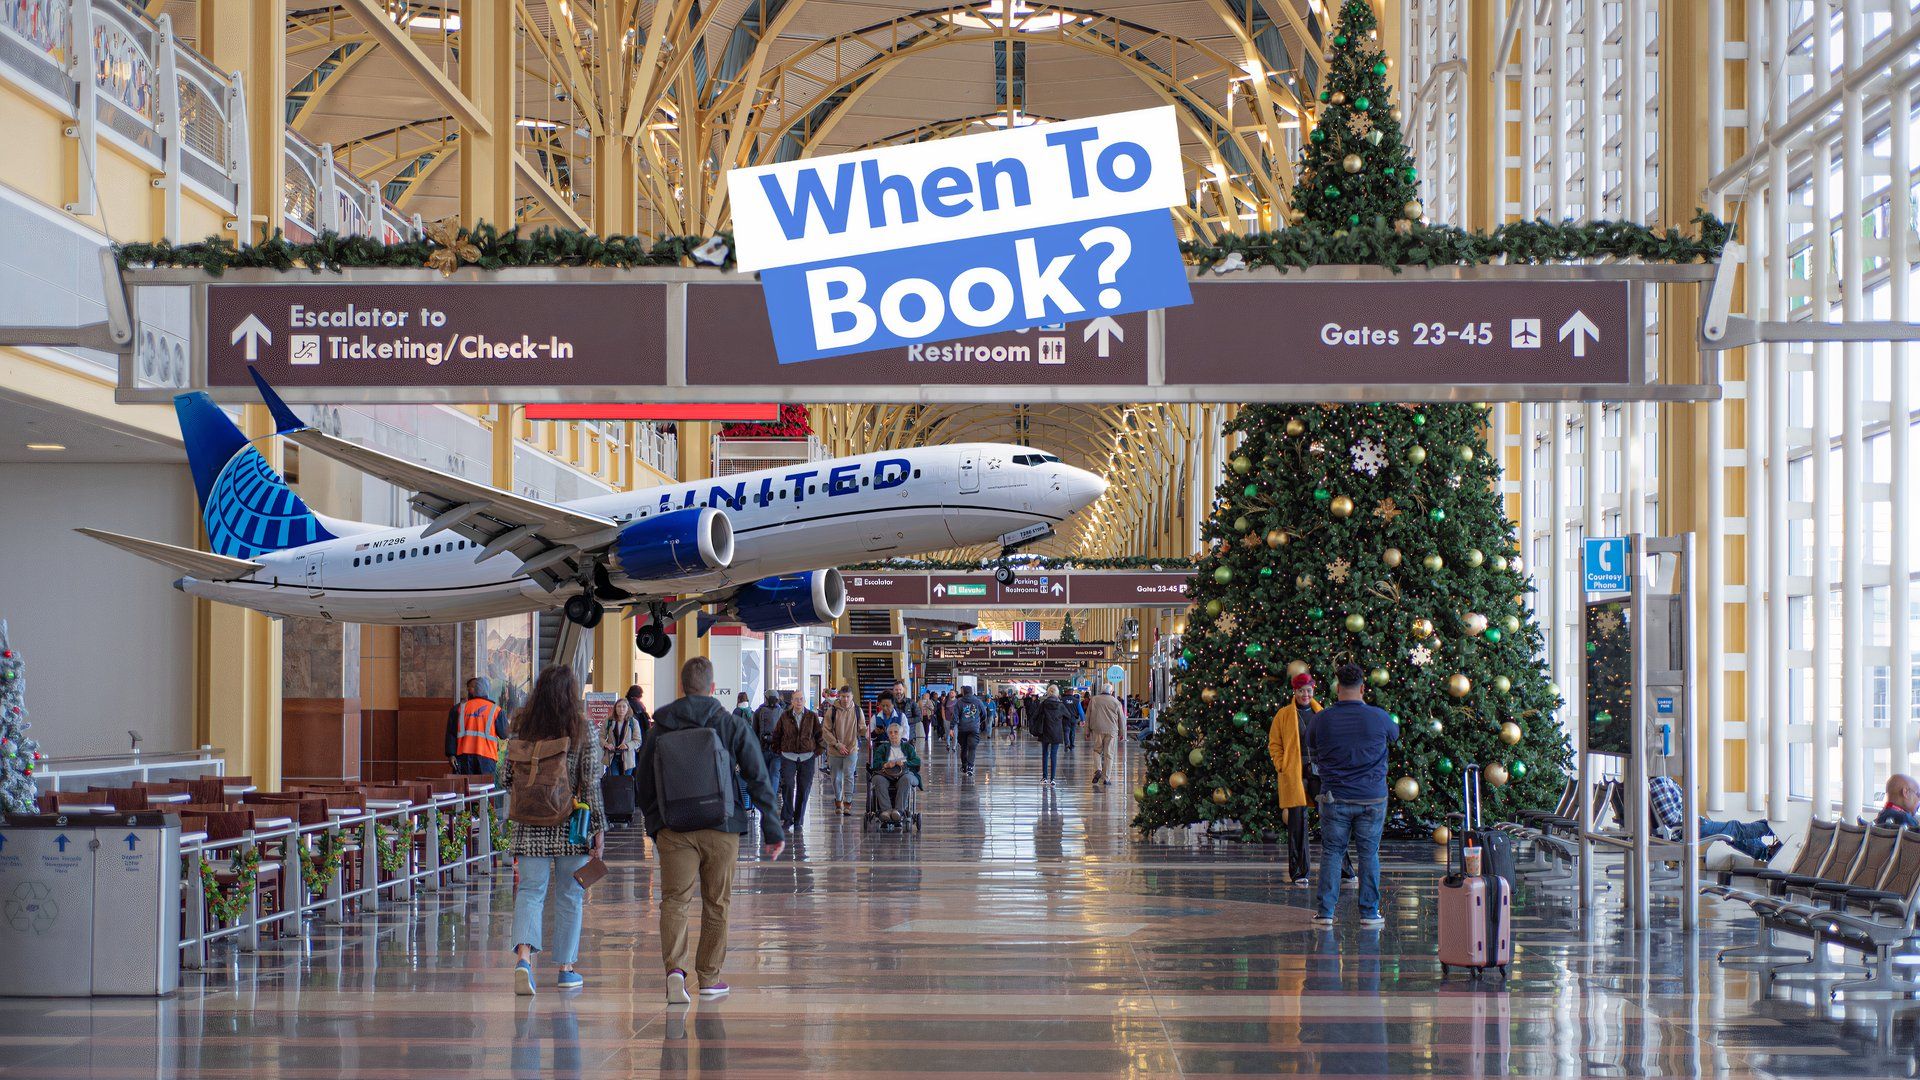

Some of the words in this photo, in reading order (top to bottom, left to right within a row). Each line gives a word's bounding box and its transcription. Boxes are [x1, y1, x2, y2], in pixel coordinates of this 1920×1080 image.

[290, 304, 409, 328] Escalator
[421, 307, 447, 328] to
[1320, 322, 1400, 346] Gates
[1412, 322, 1493, 345] 23-45
[328, 333, 574, 366] Ticketing/Check-In
[908, 343, 1031, 362] Restroom
[658, 458, 911, 513] UNITED
[372, 537, 406, 549] N17296
[864, 578, 893, 586] Escalator
[1014, 578, 1038, 586] Parking
[1587, 572, 1622, 582] Courtesy
[1593, 581, 1617, 589] Phone
